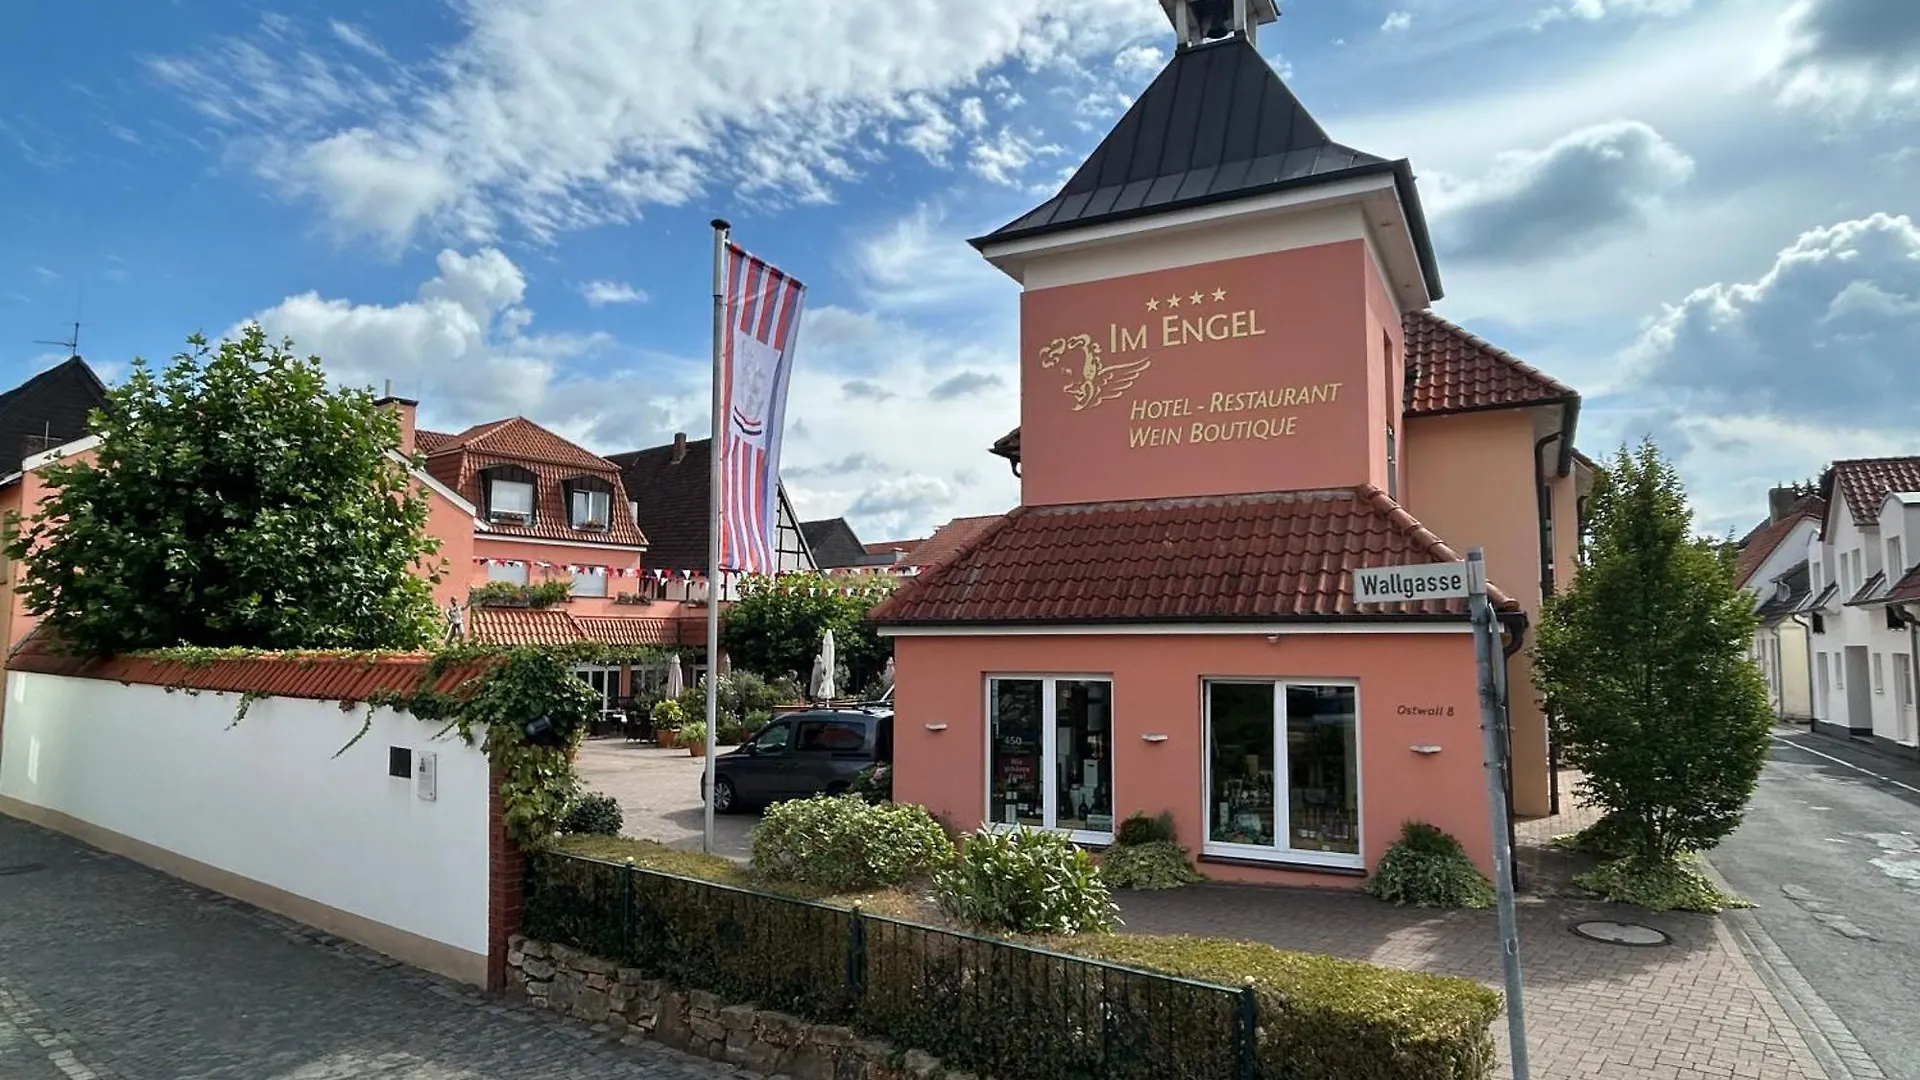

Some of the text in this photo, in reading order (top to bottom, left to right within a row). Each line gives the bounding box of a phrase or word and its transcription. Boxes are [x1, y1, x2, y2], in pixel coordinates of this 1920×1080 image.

[1109, 309, 1266, 353] IM ENGEL
[1130, 398, 1192, 420] HOTEL
[1209, 382, 1343, 413] RESTAURANT
[1129, 416, 1298, 448] WEIN BOUTIQUE
[1361, 574, 1461, 598] Wallgasse
[1397, 704, 1454, 717] Ostwall 8
